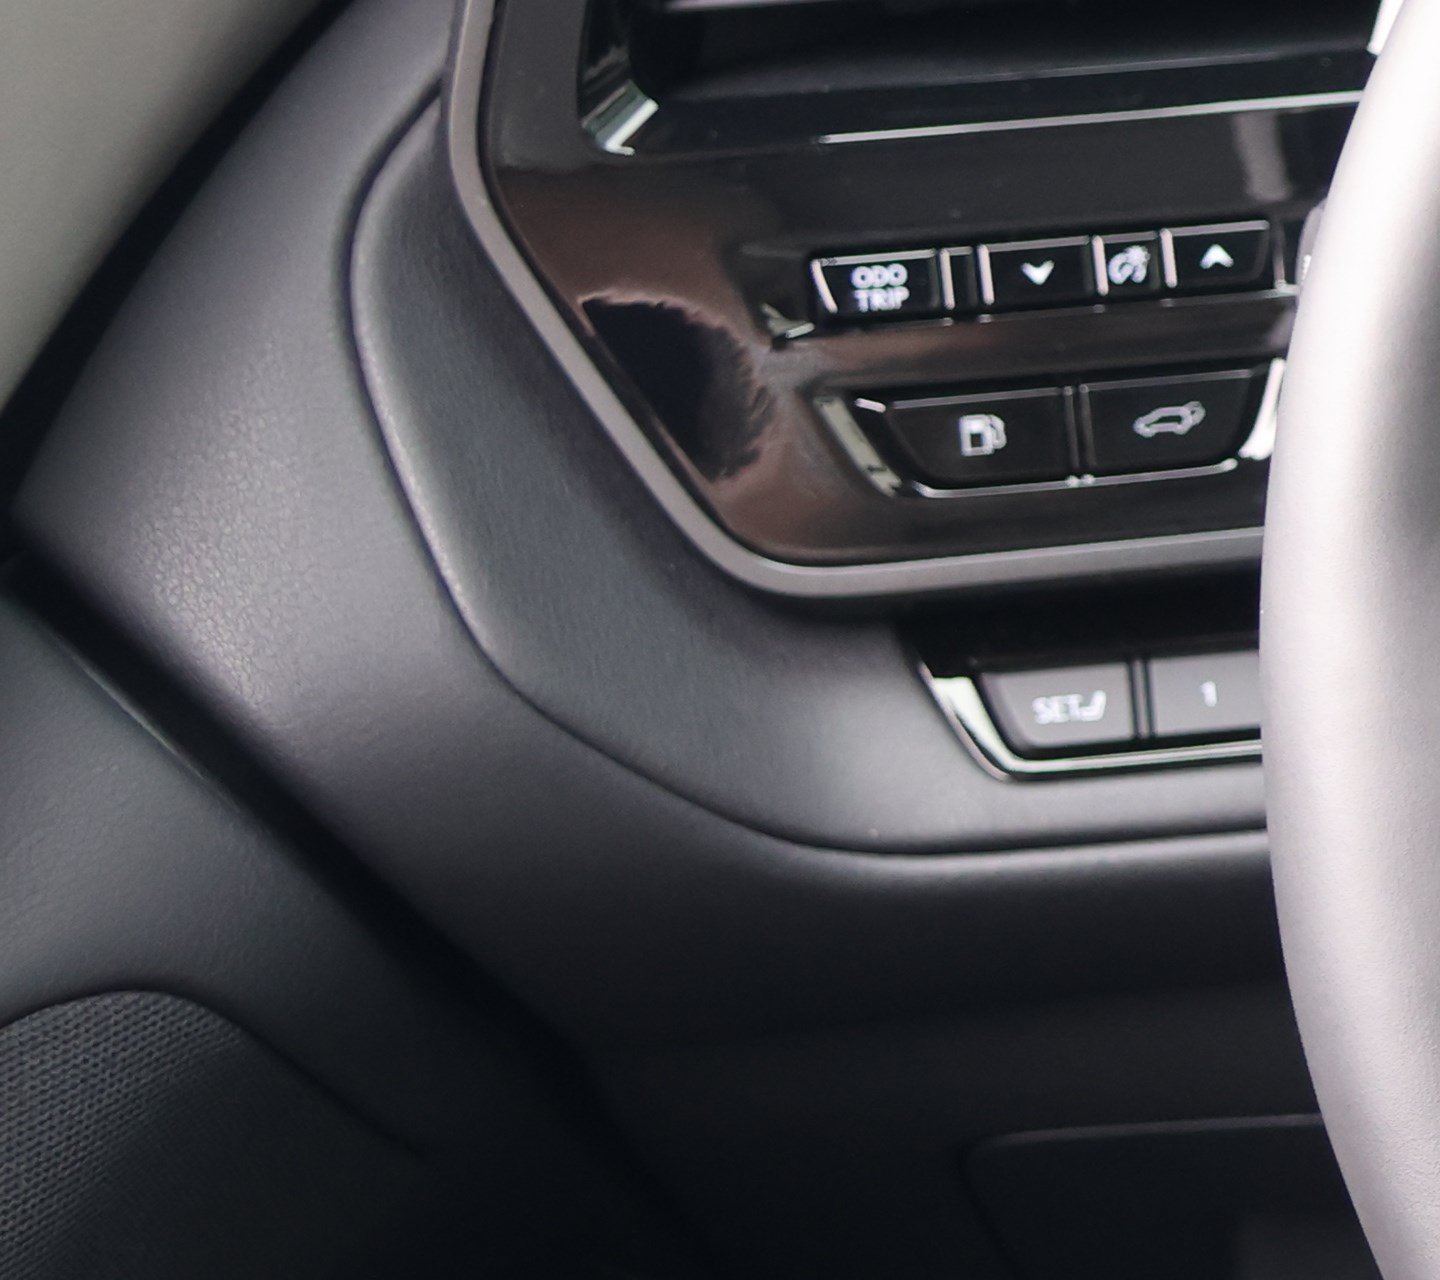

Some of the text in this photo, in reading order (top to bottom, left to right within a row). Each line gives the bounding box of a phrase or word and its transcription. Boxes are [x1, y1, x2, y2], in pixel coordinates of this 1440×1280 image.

[851, 263, 909, 289] ODO
[853, 286, 910, 313] TRIP
[1200, 680, 1218, 708] 1
